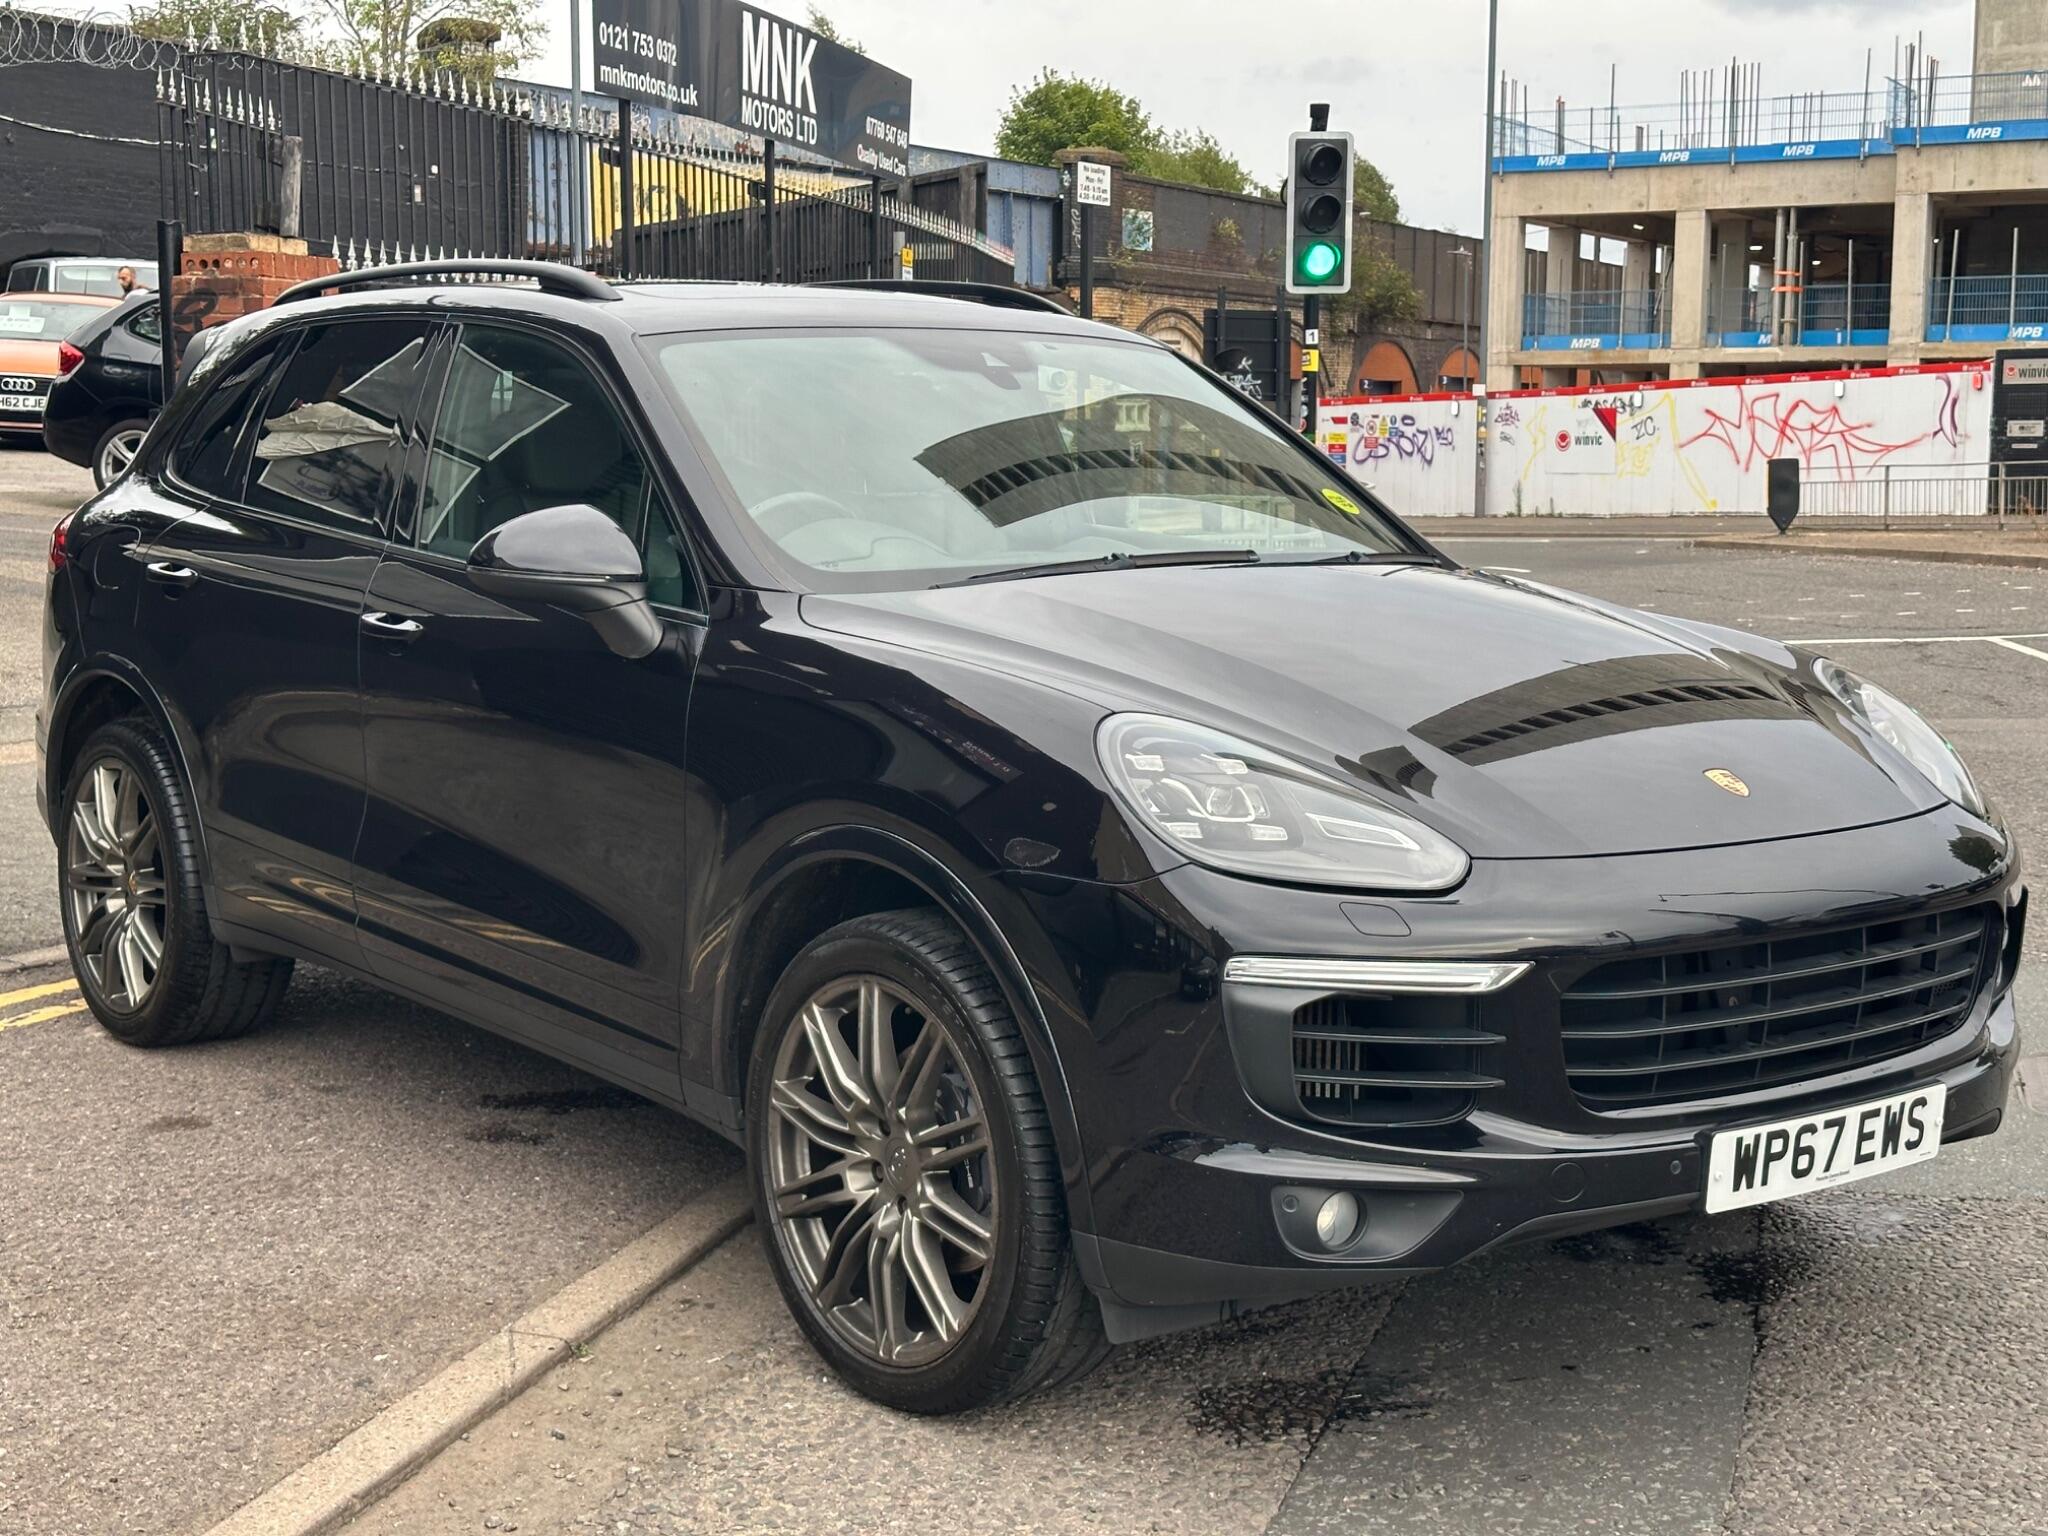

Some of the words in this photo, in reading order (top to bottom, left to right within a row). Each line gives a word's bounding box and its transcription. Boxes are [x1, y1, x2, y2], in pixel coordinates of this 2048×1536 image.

[599, 21, 628, 52] 0121
[632, 30, 654, 58] 753
[656, 38, 677, 67] 0372
[742, 9, 818, 115] MNK
[600, 63, 698, 107] mnkmotors.co.uk
[741, 94, 794, 138] MOTORS
[796, 112, 818, 146] LTD
[1966, 126, 2003, 139] MPB
[1659, 150, 1690, 163] MPB
[1782, 144, 1816, 157] MPB
[857, 143, 878, 170] Quality
[878, 151, 894, 172] Used
[893, 156, 906, 177] Cars
[1536, 154, 1567, 168] MPB
[1308, 331, 1316, 343] 1
[2007, 326, 2044, 339] MPB
[1570, 337, 1601, 349] MPB
[22, 397, 46, 409] CJE
[1574, 431, 1603, 446] winvic
[1732, 1114, 1848, 1193] WP67
[1853, 1096, 1928, 1167] EWS
